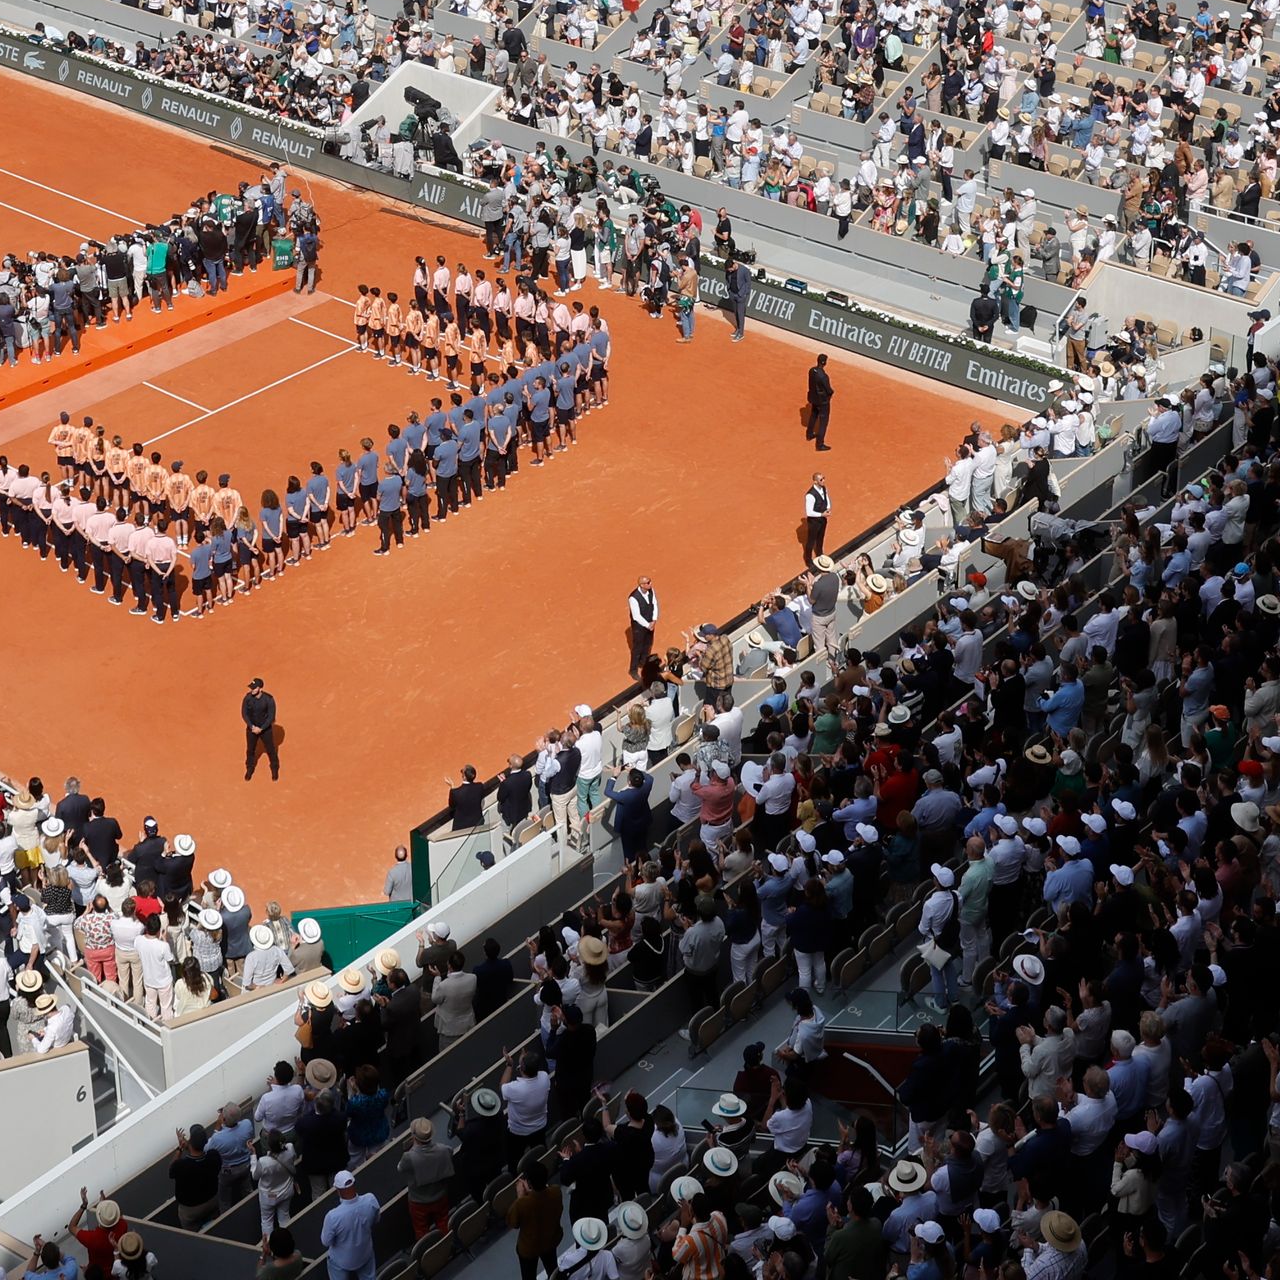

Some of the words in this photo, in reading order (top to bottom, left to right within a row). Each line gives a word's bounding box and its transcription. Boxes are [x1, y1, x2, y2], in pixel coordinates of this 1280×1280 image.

[77, 70, 132, 98] RENAULT
[161, 98, 221, 127] RENAULT
[251, 128, 315, 159] RENAULT
[755, 292, 796, 321] BETTER
[808, 307, 883, 350] Emirates
[887, 334, 911, 361] FLY
[908, 338, 952, 373] BETTER
[965, 360, 1047, 404] Emirates
[637, 1060, 654, 1072] 02
[76, 1085, 87, 1103] 6
